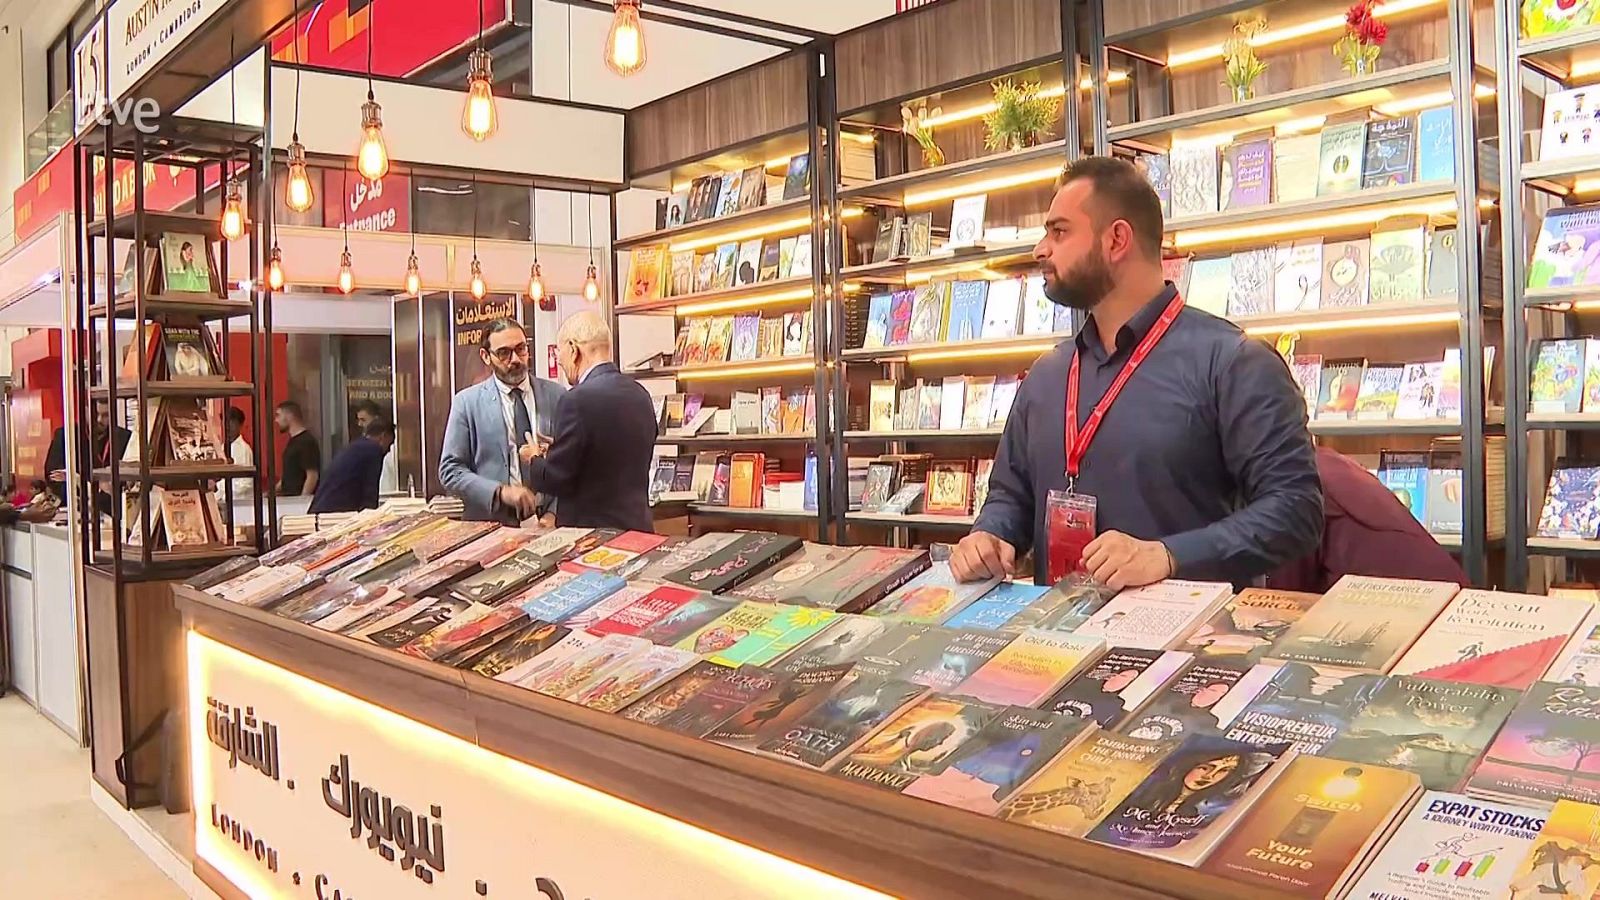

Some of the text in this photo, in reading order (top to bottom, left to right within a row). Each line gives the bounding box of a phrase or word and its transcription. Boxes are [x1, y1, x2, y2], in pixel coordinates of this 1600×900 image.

[126, 0, 159, 46] AUSTYN
[126, 0, 201, 75] LONDON CAMBRIDGE
[350, 177, 383, 212] مدخل
[1456, 607, 1490, 616] Work
[1460, 598, 1541, 613] Decent
[1446, 614, 1545, 631] Revolution
[1025, 636, 1046, 646] Old
[1059, 642, 1086, 651] Bold
[1396, 679, 1508, 705] Vulnerability
[1405, 695, 1474, 714] Power
[1030, 719, 1054, 729] and
[1241, 710, 1337, 739] VISIOPRENEUR
[206, 696, 280, 780] الشارقة
[785, 729, 841, 752] OATH
[1235, 722, 1330, 746] THE TOMORROW
[1089, 745, 1147, 762] THE INNER
[1096, 737, 1161, 754] EMBRACING
[1080, 752, 1113, 765] CHILD
[1496, 780, 1548, 794] PRIYANKA
[1294, 794, 1363, 813] Switch
[321, 753, 446, 884] نيويورك
[1154, 811, 1210, 828] Myself
[1427, 799, 1546, 832] EXPAT STOCKS
[1421, 813, 1538, 841] A JOURNEY WORTH TAKING
[1267, 839, 1313, 857] Your
[1246, 847, 1314, 870] Future
